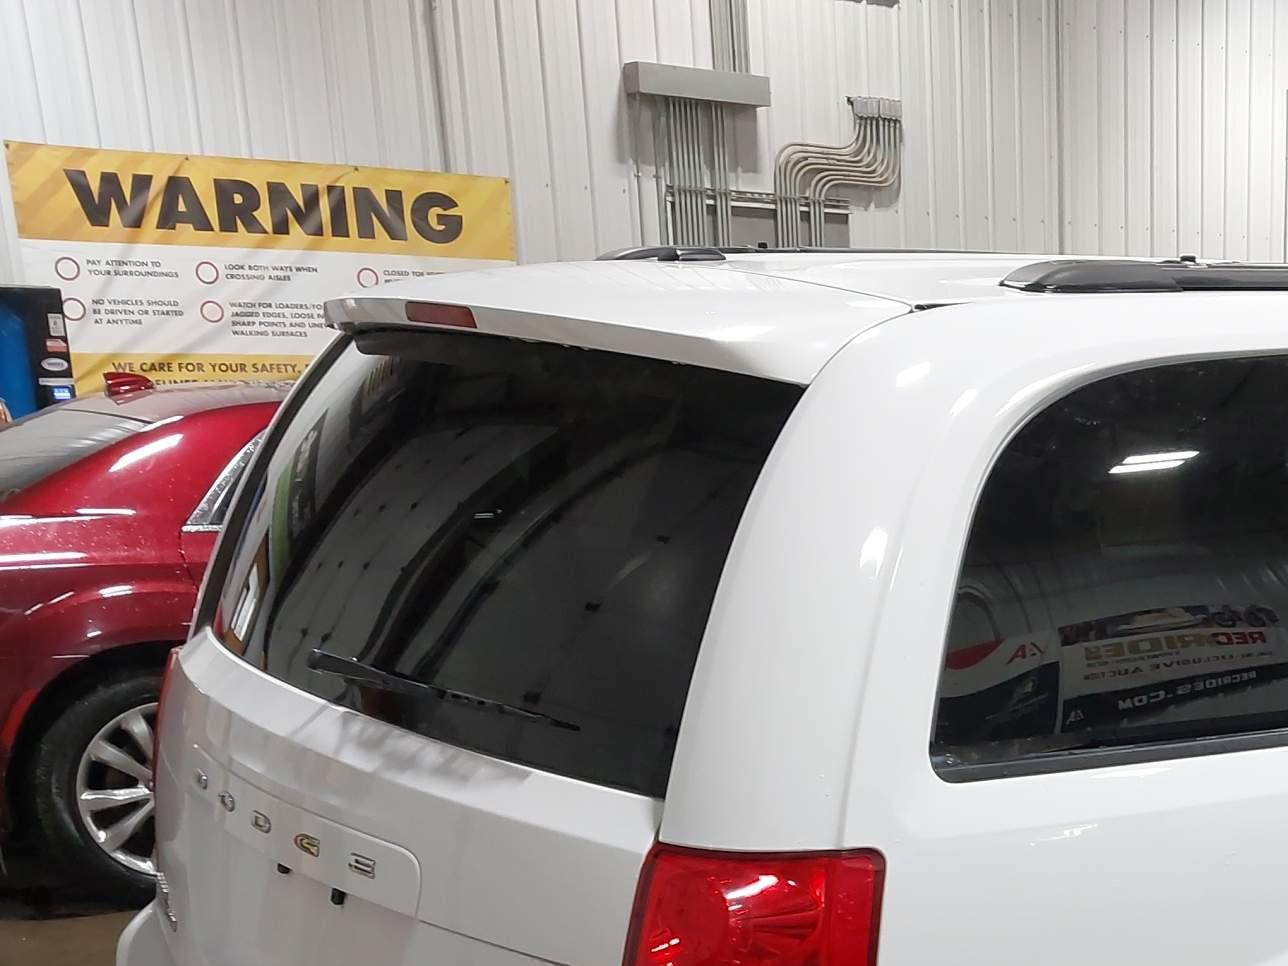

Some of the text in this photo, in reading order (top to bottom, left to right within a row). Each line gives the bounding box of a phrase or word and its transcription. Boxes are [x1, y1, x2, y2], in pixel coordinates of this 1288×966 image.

[63, 168, 463, 245] WARNING
[105, 259, 148, 267] ATTENTION
[151, 260, 161, 268] TO
[248, 264, 268, 272] BOTH
[113, 269, 179, 278] SURROUNDINGS
[225, 273, 265, 281] CROSSING
[106, 318, 143, 326] ANYTIME
[232, 329, 269, 337] WALKING
[112, 362, 135, 372] WE
[140, 362, 173, 373] CARE
[178, 362, 206, 373] FOR
[209, 362, 248, 374] YOUR
[251, 363, 301, 374] SAFETY,
